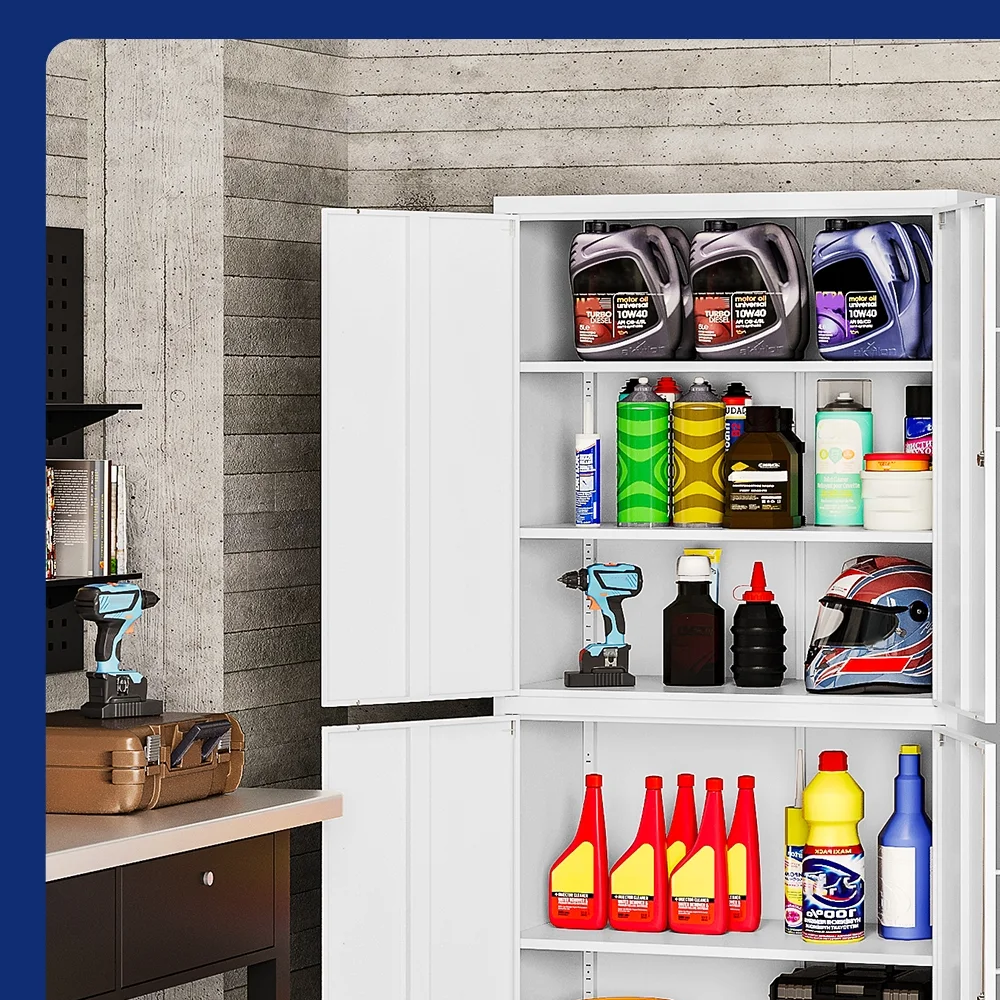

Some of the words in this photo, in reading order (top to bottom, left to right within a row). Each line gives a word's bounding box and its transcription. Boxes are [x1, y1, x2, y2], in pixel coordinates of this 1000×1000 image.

[617, 310, 648, 319] 10W40
[735, 309, 767, 318] 10W40
[849, 309, 878, 318] 10W40
